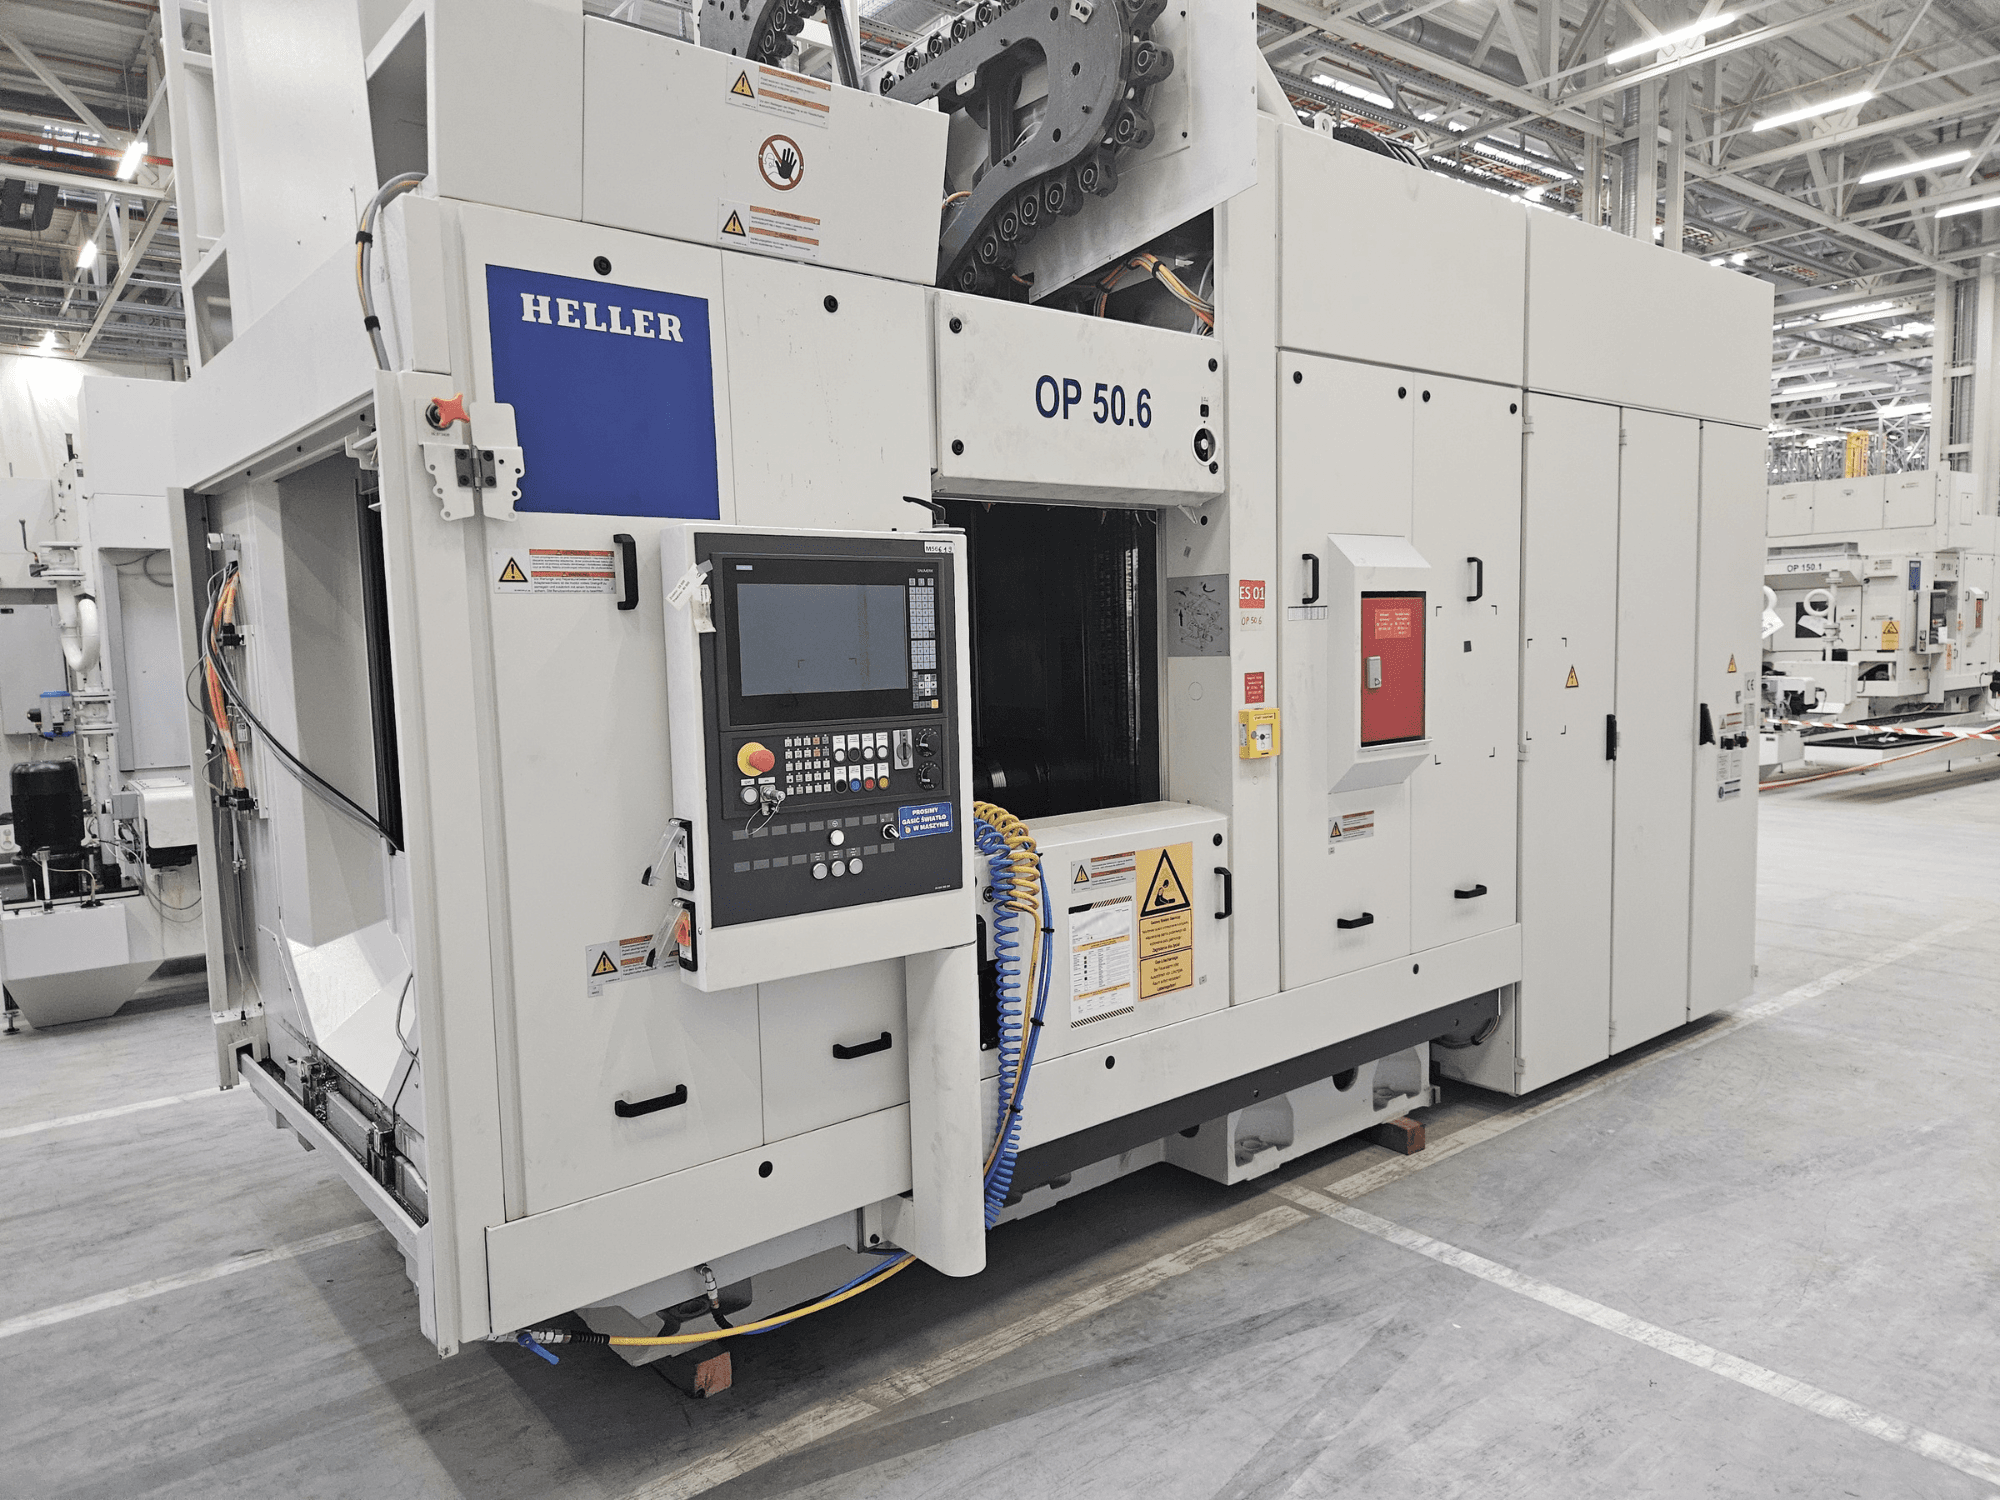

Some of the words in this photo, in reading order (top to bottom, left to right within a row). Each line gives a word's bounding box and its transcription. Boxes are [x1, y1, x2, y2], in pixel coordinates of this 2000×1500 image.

[520, 293, 683, 343] HELLER
[1035, 375, 1082, 420] OP
[1093, 382, 1152, 429] 50.6
[1787, 564, 1799, 573] OP
[1801, 563, 1822, 571] 150.1
[1240, 586, 1251, 600] ES
[1253, 586, 1265, 600] 01
[912, 807, 939, 816] PROSIMY
[902, 817, 921, 825] GASIĆ
[921, 814, 947, 823] ŚWIATŁO
[920, 821, 949, 830] MASZYNIE
